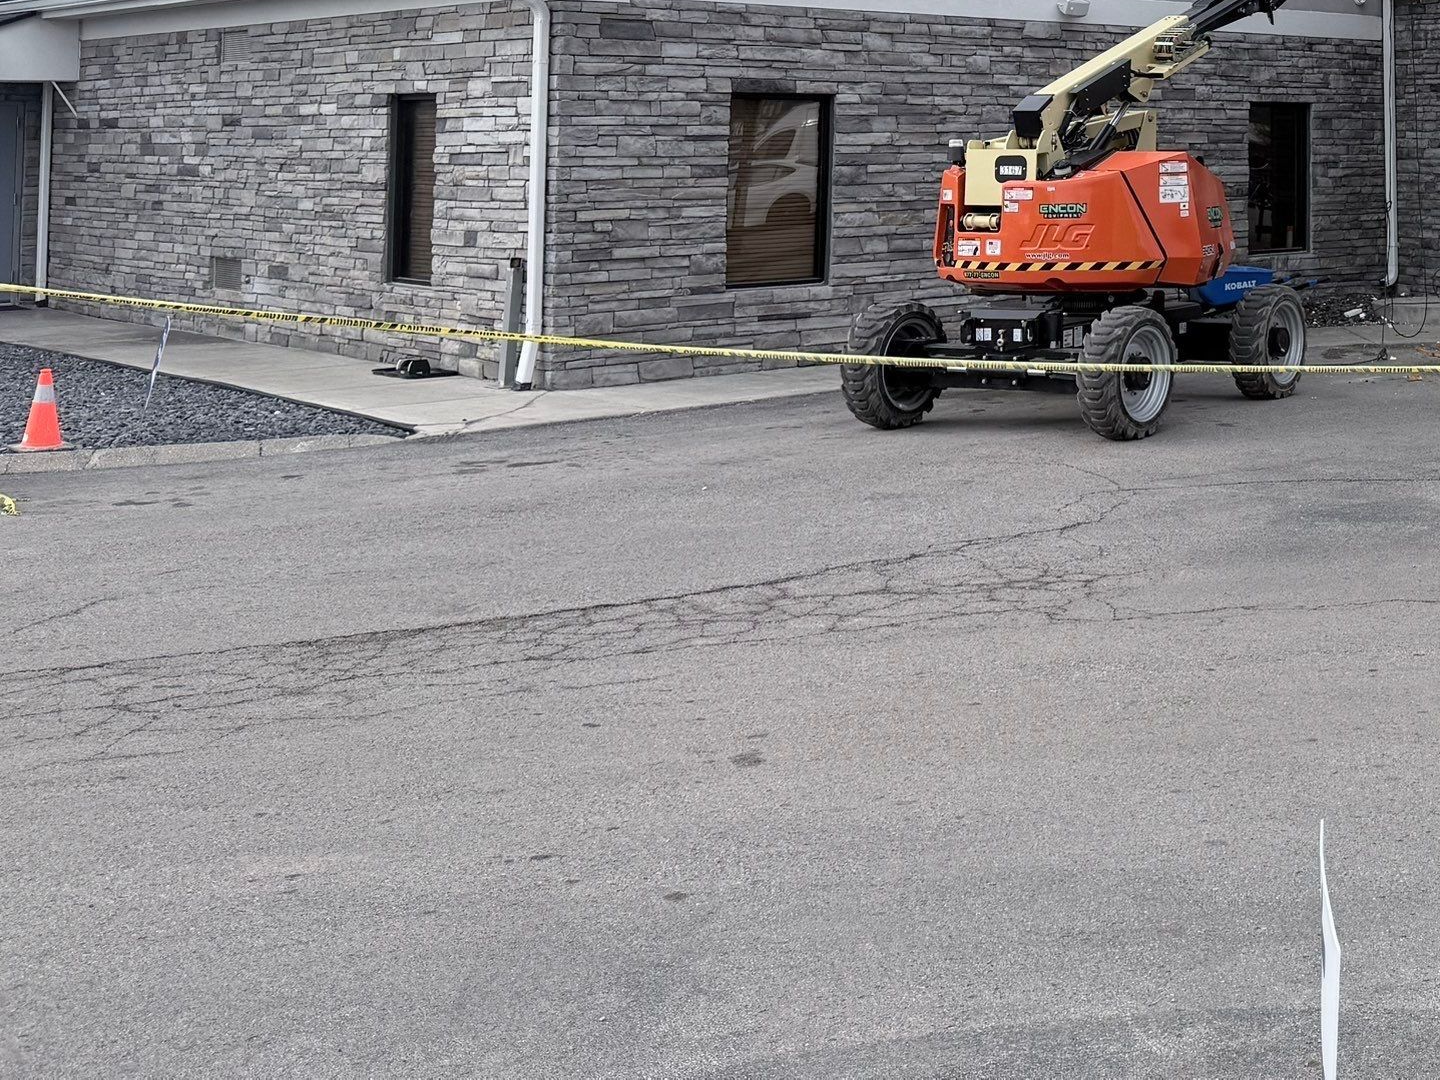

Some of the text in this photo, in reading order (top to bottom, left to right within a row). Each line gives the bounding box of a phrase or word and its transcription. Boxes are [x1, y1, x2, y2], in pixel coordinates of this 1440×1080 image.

[1040, 204, 1086, 213] ENCON
[1019, 223, 1095, 251] JLG
[1024, 251, 1070, 260] www.jlg.com
[1224, 280, 1257, 291] KOBALT
